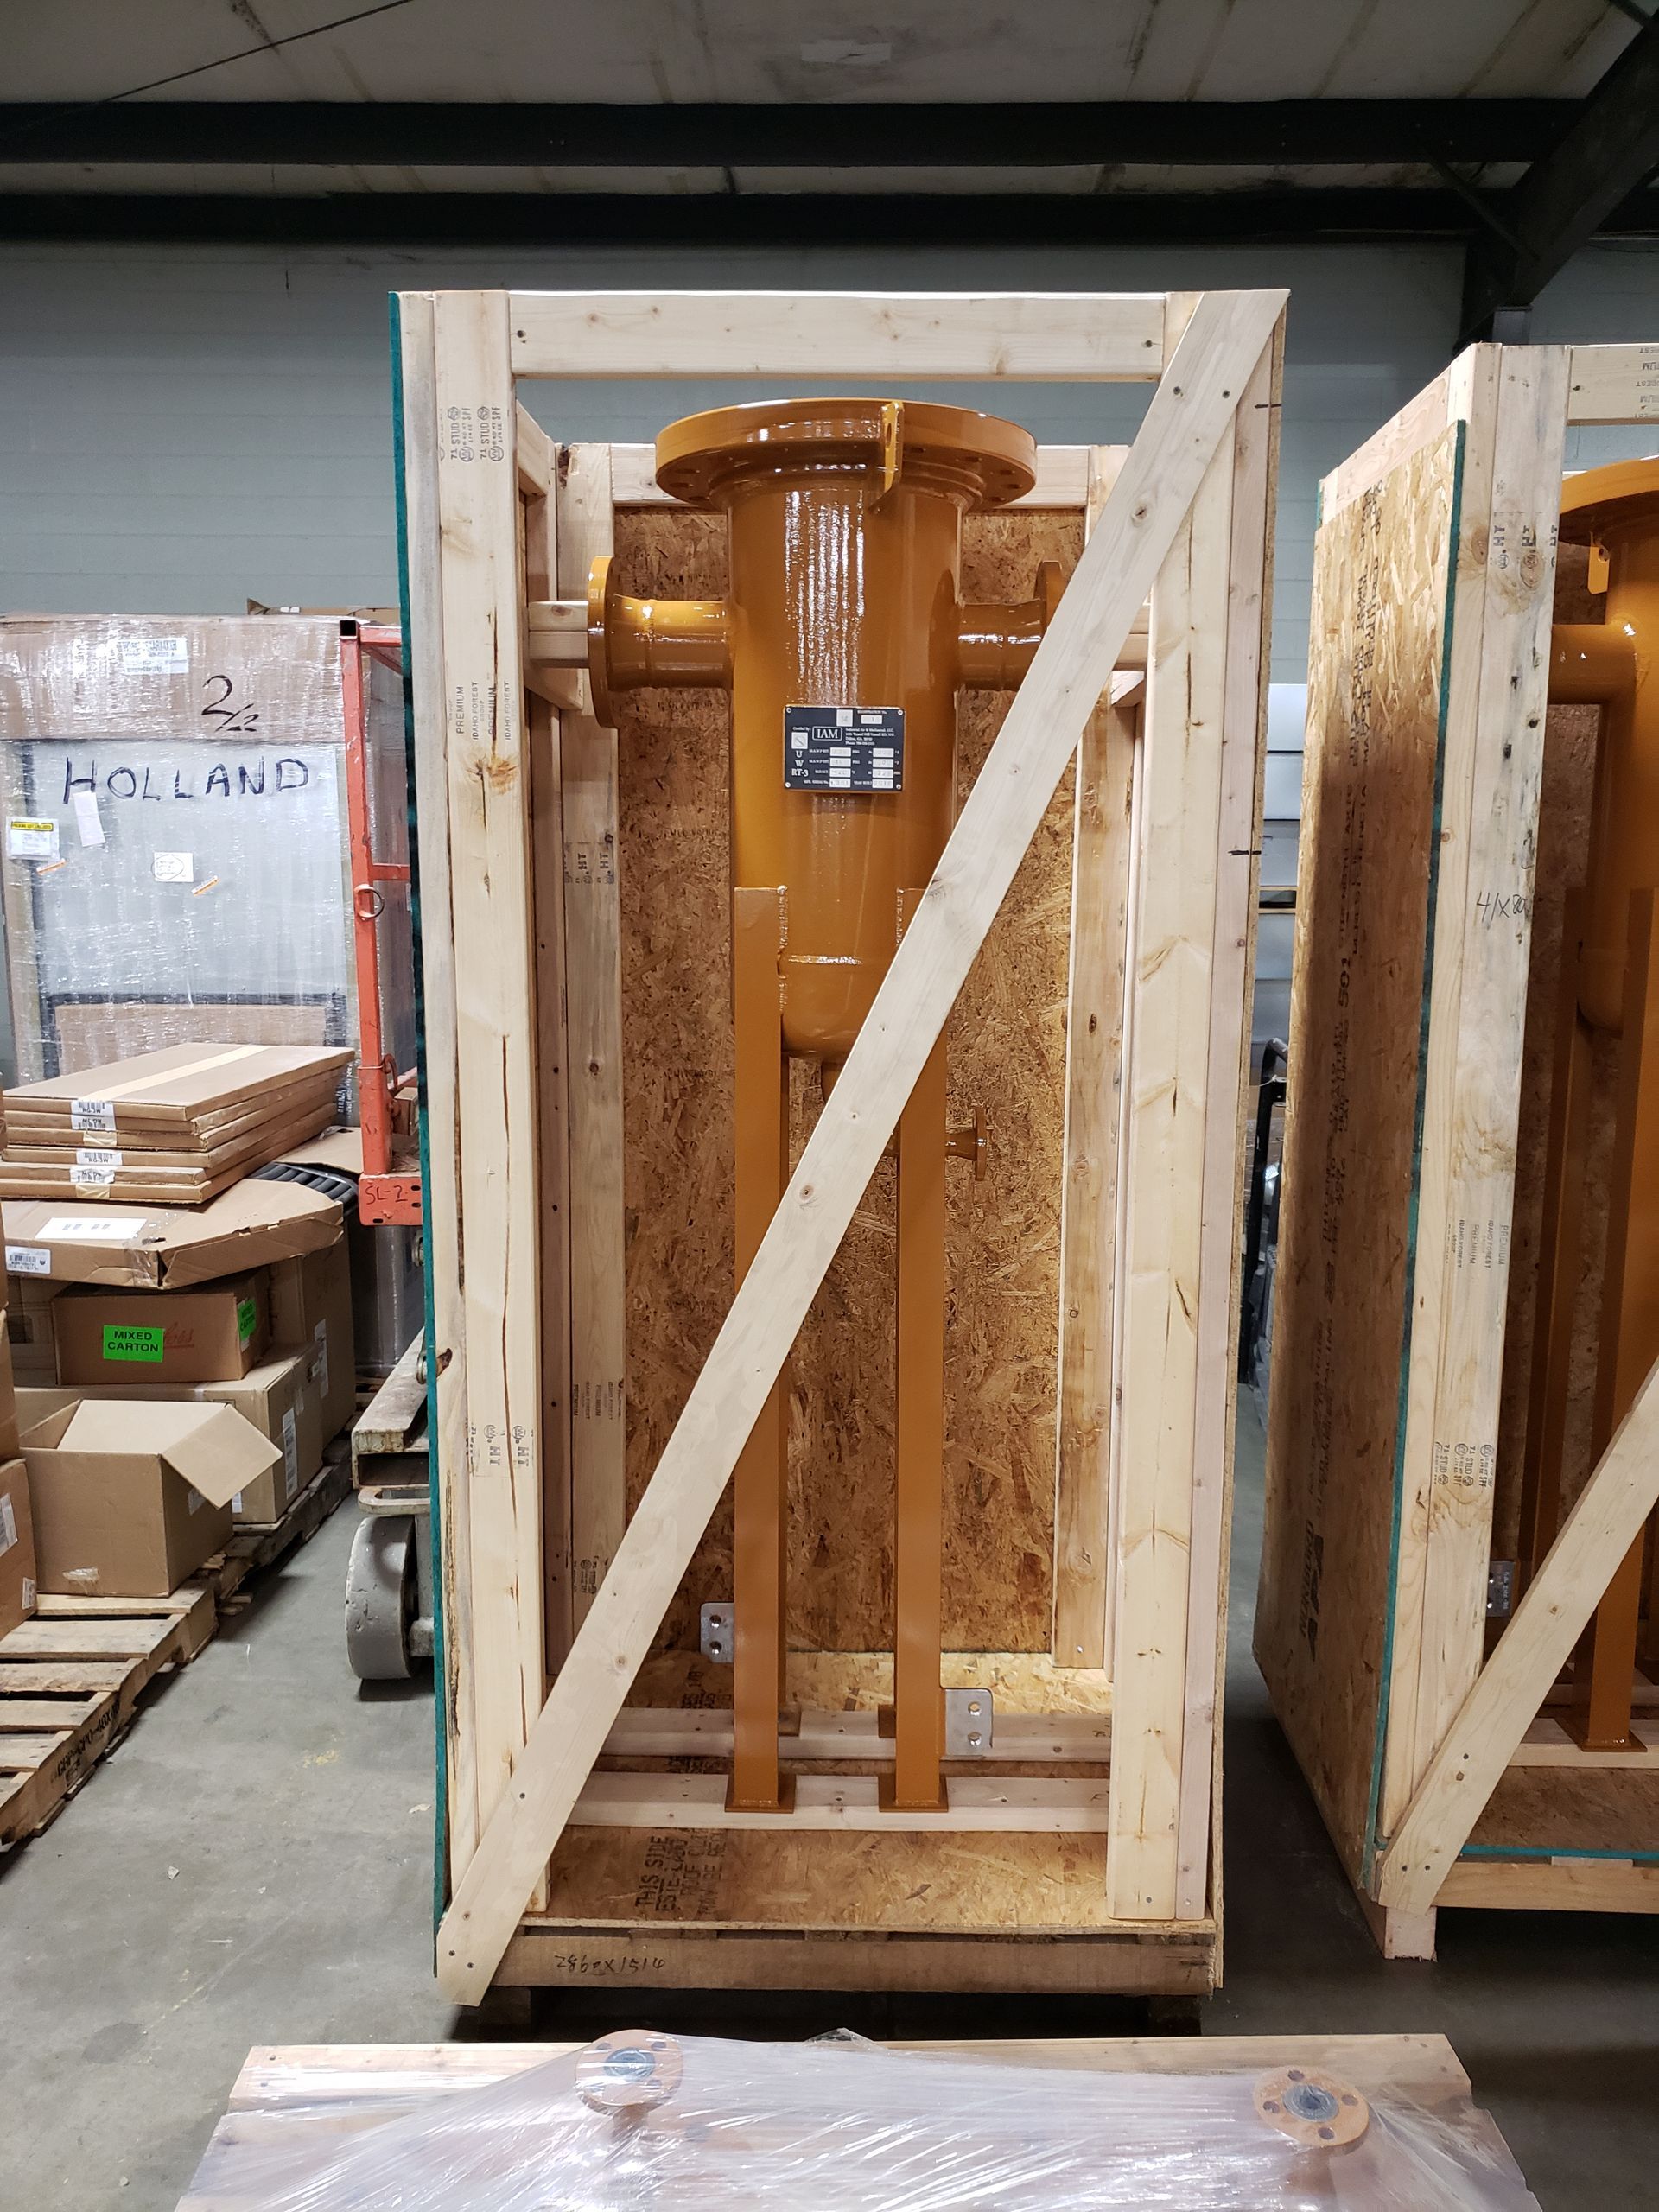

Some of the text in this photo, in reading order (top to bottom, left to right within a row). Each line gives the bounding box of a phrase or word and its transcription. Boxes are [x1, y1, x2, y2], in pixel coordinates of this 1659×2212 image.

[450, 423, 461, 445] STUD
[480, 422, 490, 444] STUD
[455, 686, 465, 734] PREMIUM
[817, 728, 838, 739] IAM
[62, 756, 309, 804] HOLLAND
[791, 768, 809, 777] RT-3
[1470, 1224, 1479, 1264] PREMIUM
[1497, 1224, 1509, 1265] PREMIUM
[107, 1341, 159, 1352] CARTON
[114, 1331, 152, 1341] MIXED
[489, 1446, 501, 1466] HT
[517, 1446, 529, 1467] HT
[1439, 1455, 1448, 1473] STUD
[1465, 1457, 1474, 1475] STUD
[635, 1835, 667, 1907] THIS SIDE
